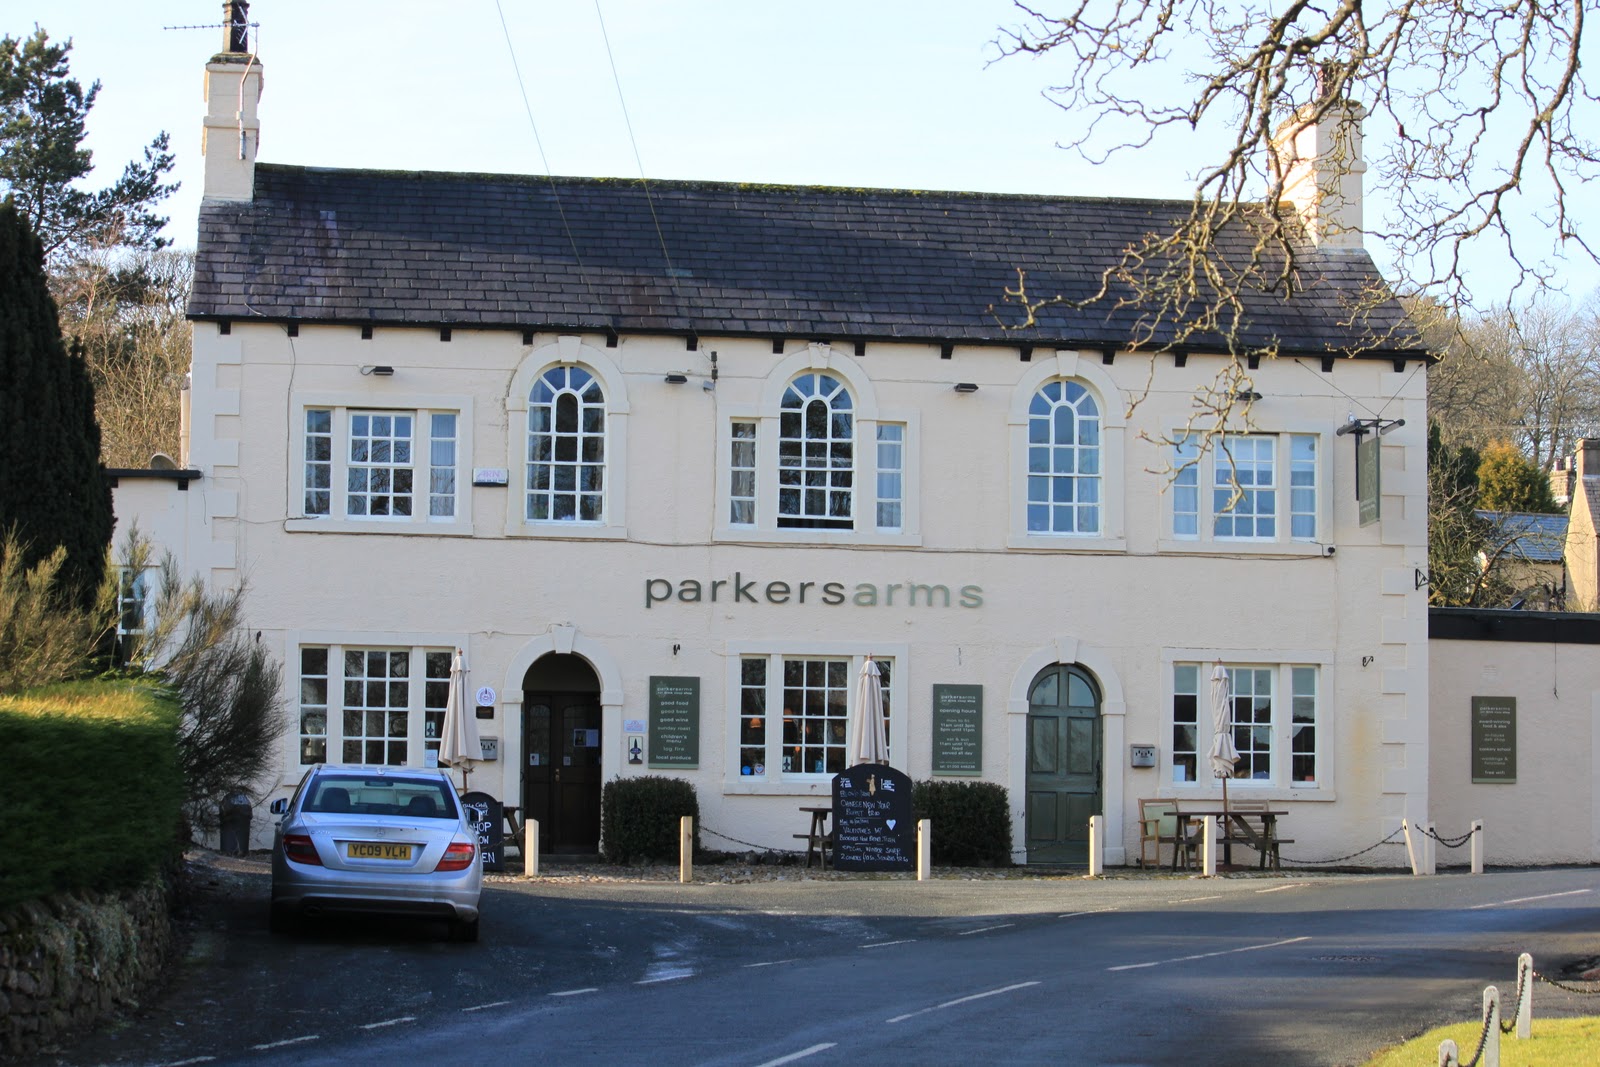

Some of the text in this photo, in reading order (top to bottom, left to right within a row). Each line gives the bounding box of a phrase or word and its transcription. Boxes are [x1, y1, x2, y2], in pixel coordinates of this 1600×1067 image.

[473, 822, 491, 832] HOP
[479, 836, 489, 844] OW
[352, 845, 407, 858] YC09 VLH
[482, 852, 495, 863] EN
